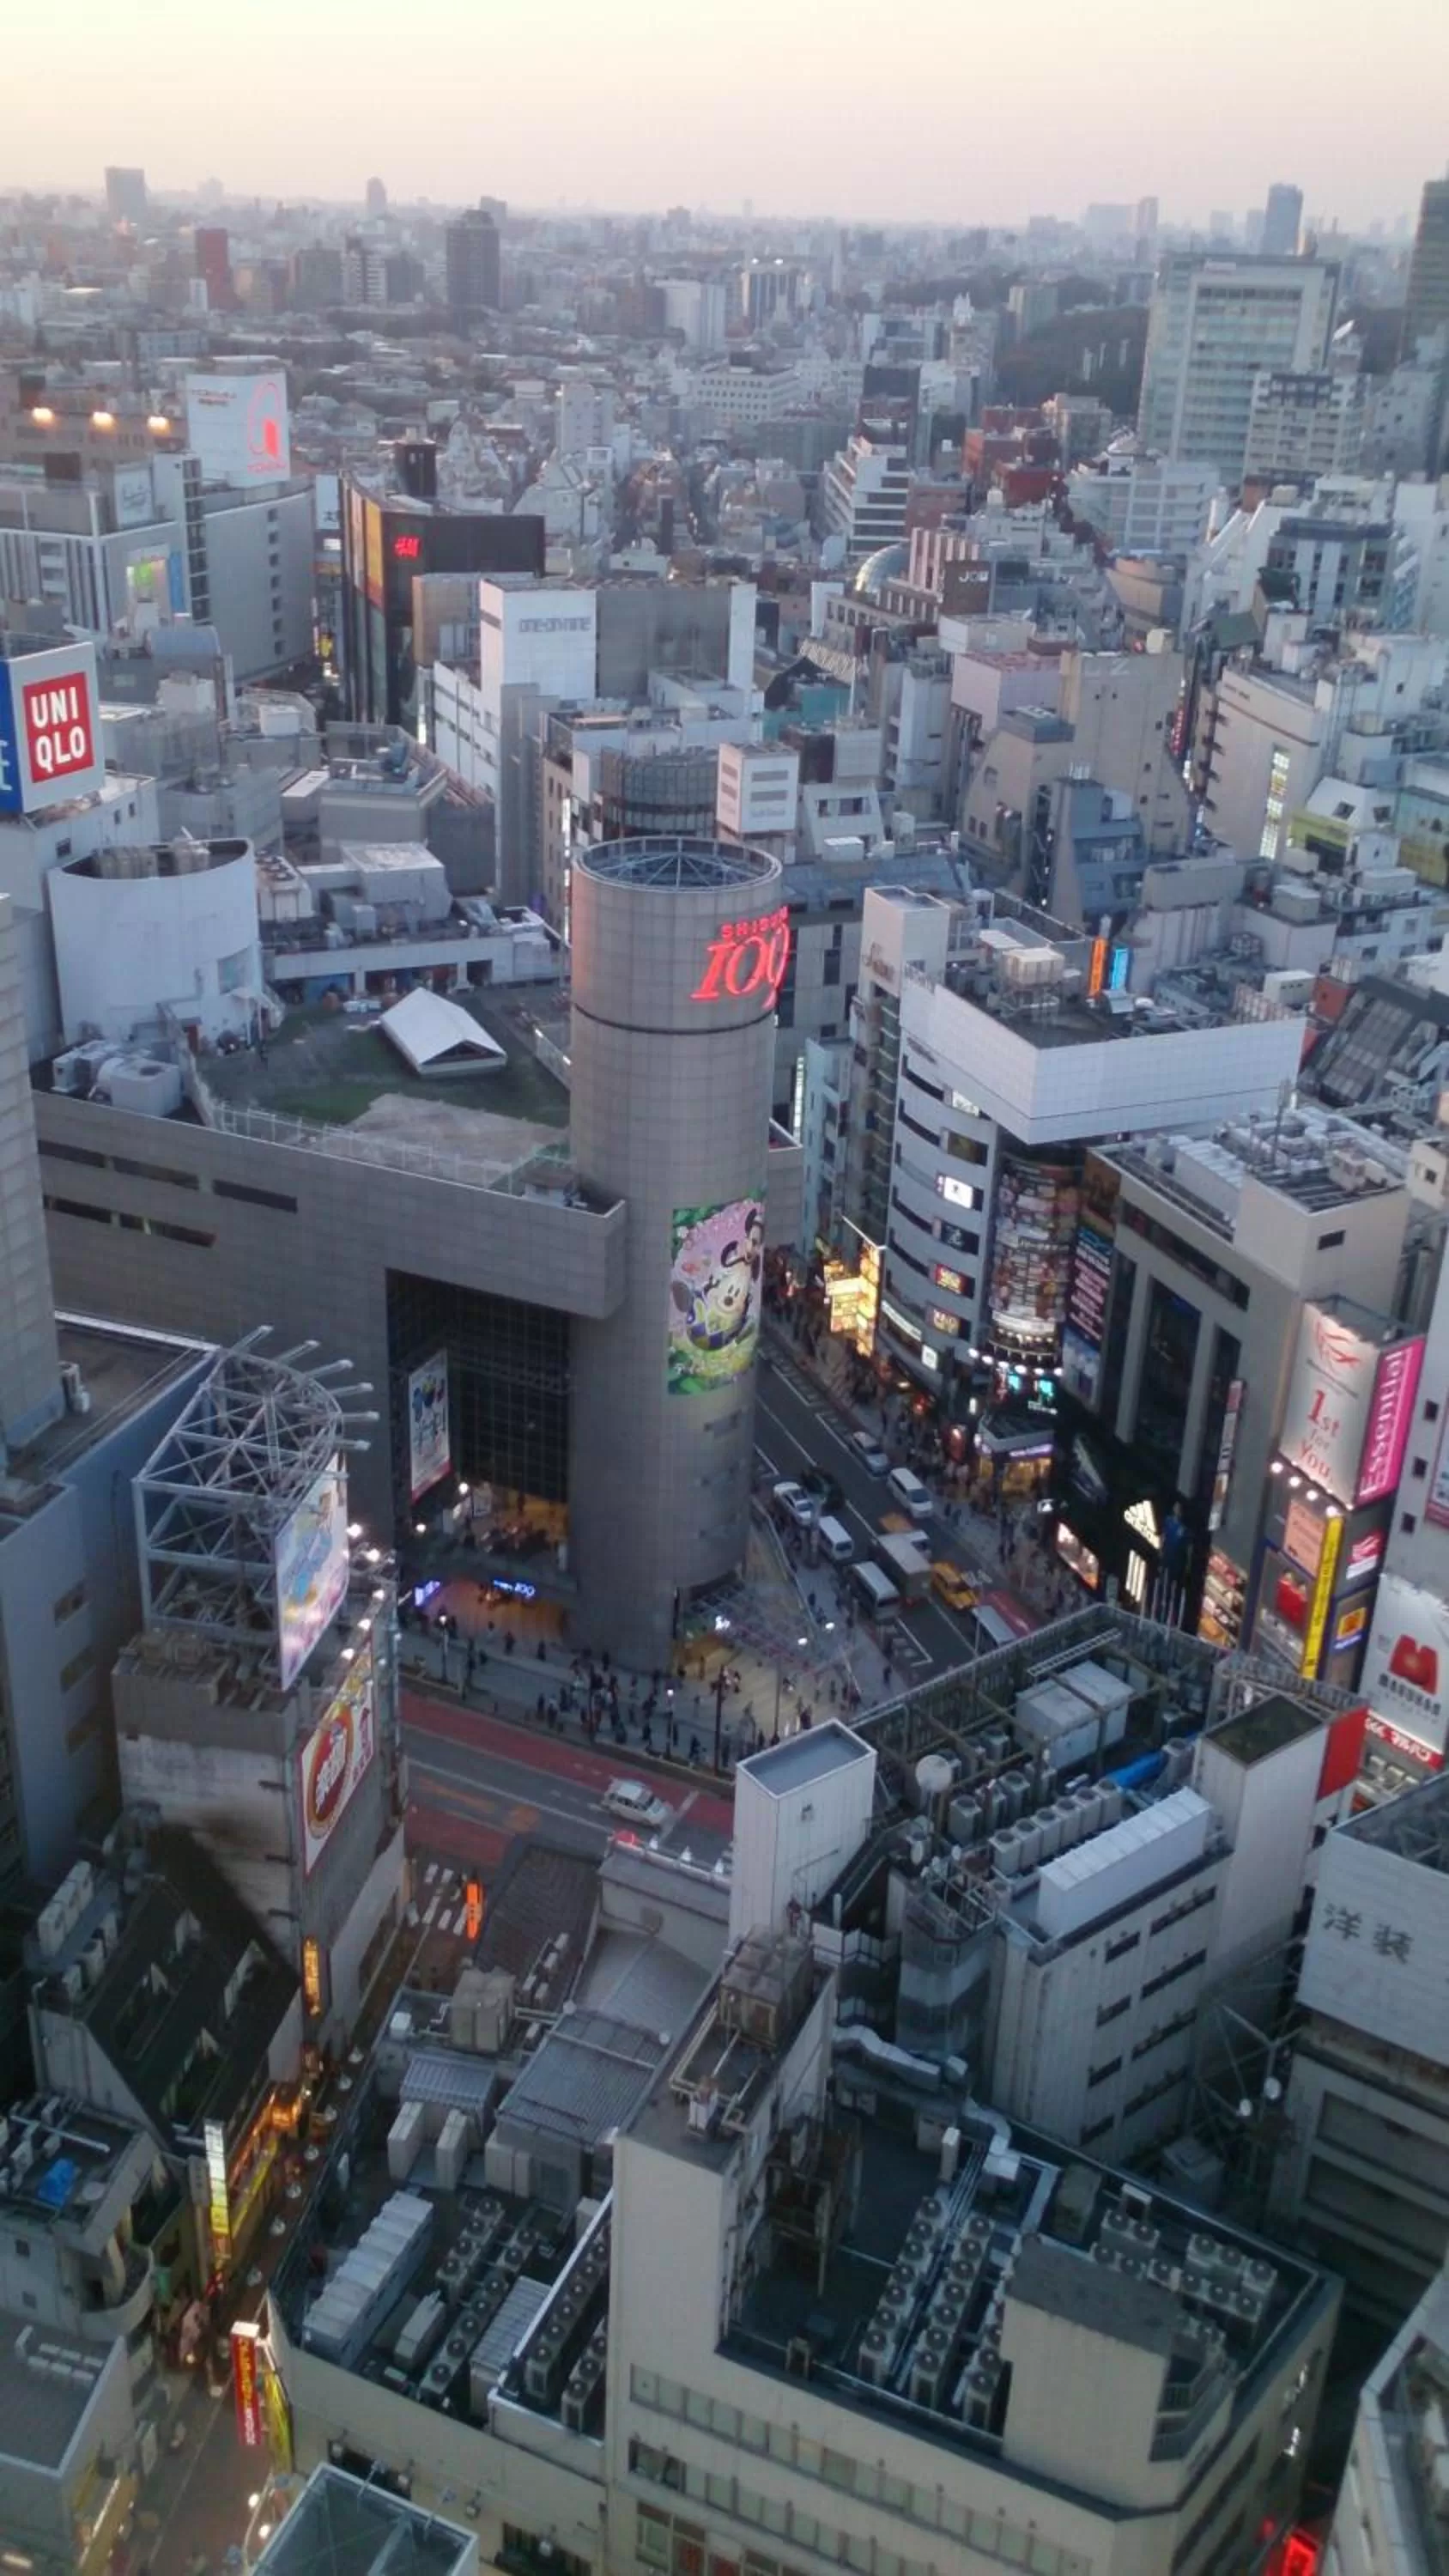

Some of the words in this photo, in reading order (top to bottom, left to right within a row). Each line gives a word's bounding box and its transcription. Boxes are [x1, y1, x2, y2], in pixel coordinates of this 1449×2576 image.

[31, 686, 79, 728] UNI
[35, 726, 86, 773] QLO
[690, 920, 790, 1011] 109
